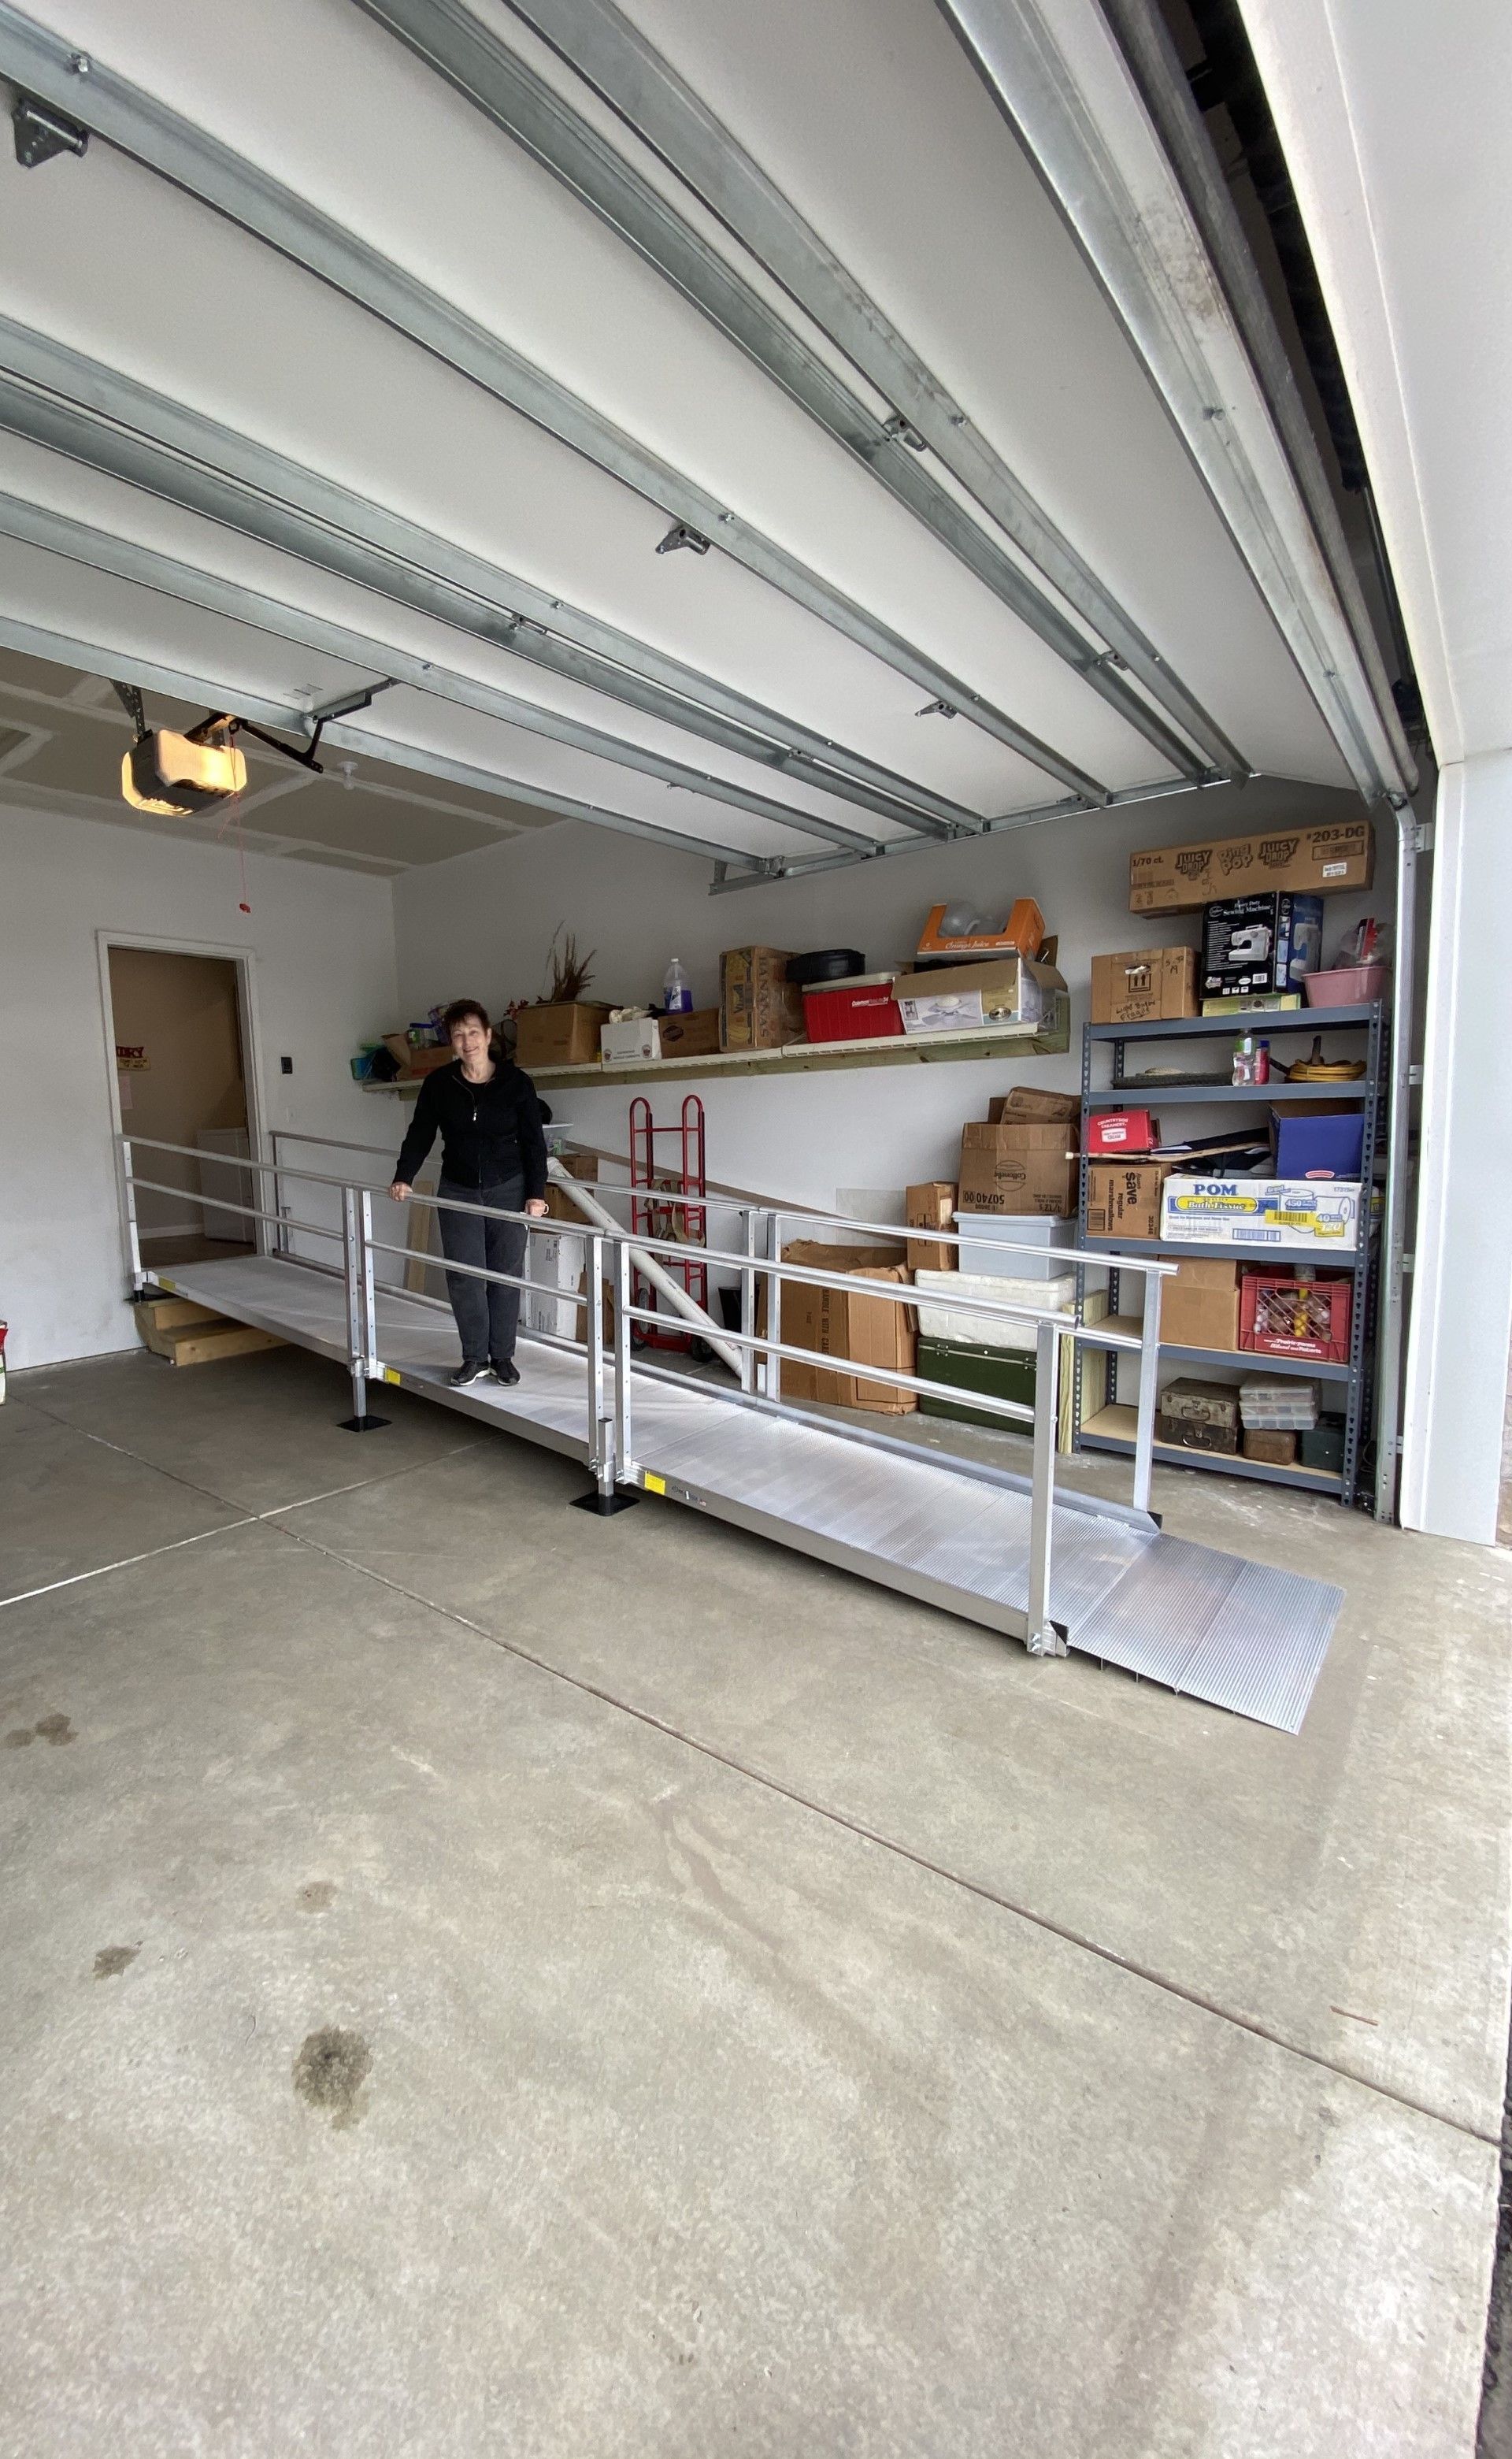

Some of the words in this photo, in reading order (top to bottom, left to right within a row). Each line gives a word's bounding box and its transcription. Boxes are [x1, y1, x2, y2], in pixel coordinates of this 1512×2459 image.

[1259, 838, 1299, 858] JUICY
[1133, 857, 1151, 866] 1/70
[1177, 851, 1212, 868] JUICY
[1182, 861, 1205, 873] DROP
[1125, 1172, 1138, 1205] save
[1193, 1184, 1237, 1196] POM
[976, 1192, 1005, 1204] 50740
[1188, 1200, 1211, 1209] Bath
[1213, 1201, 1245, 1210] Tissue
